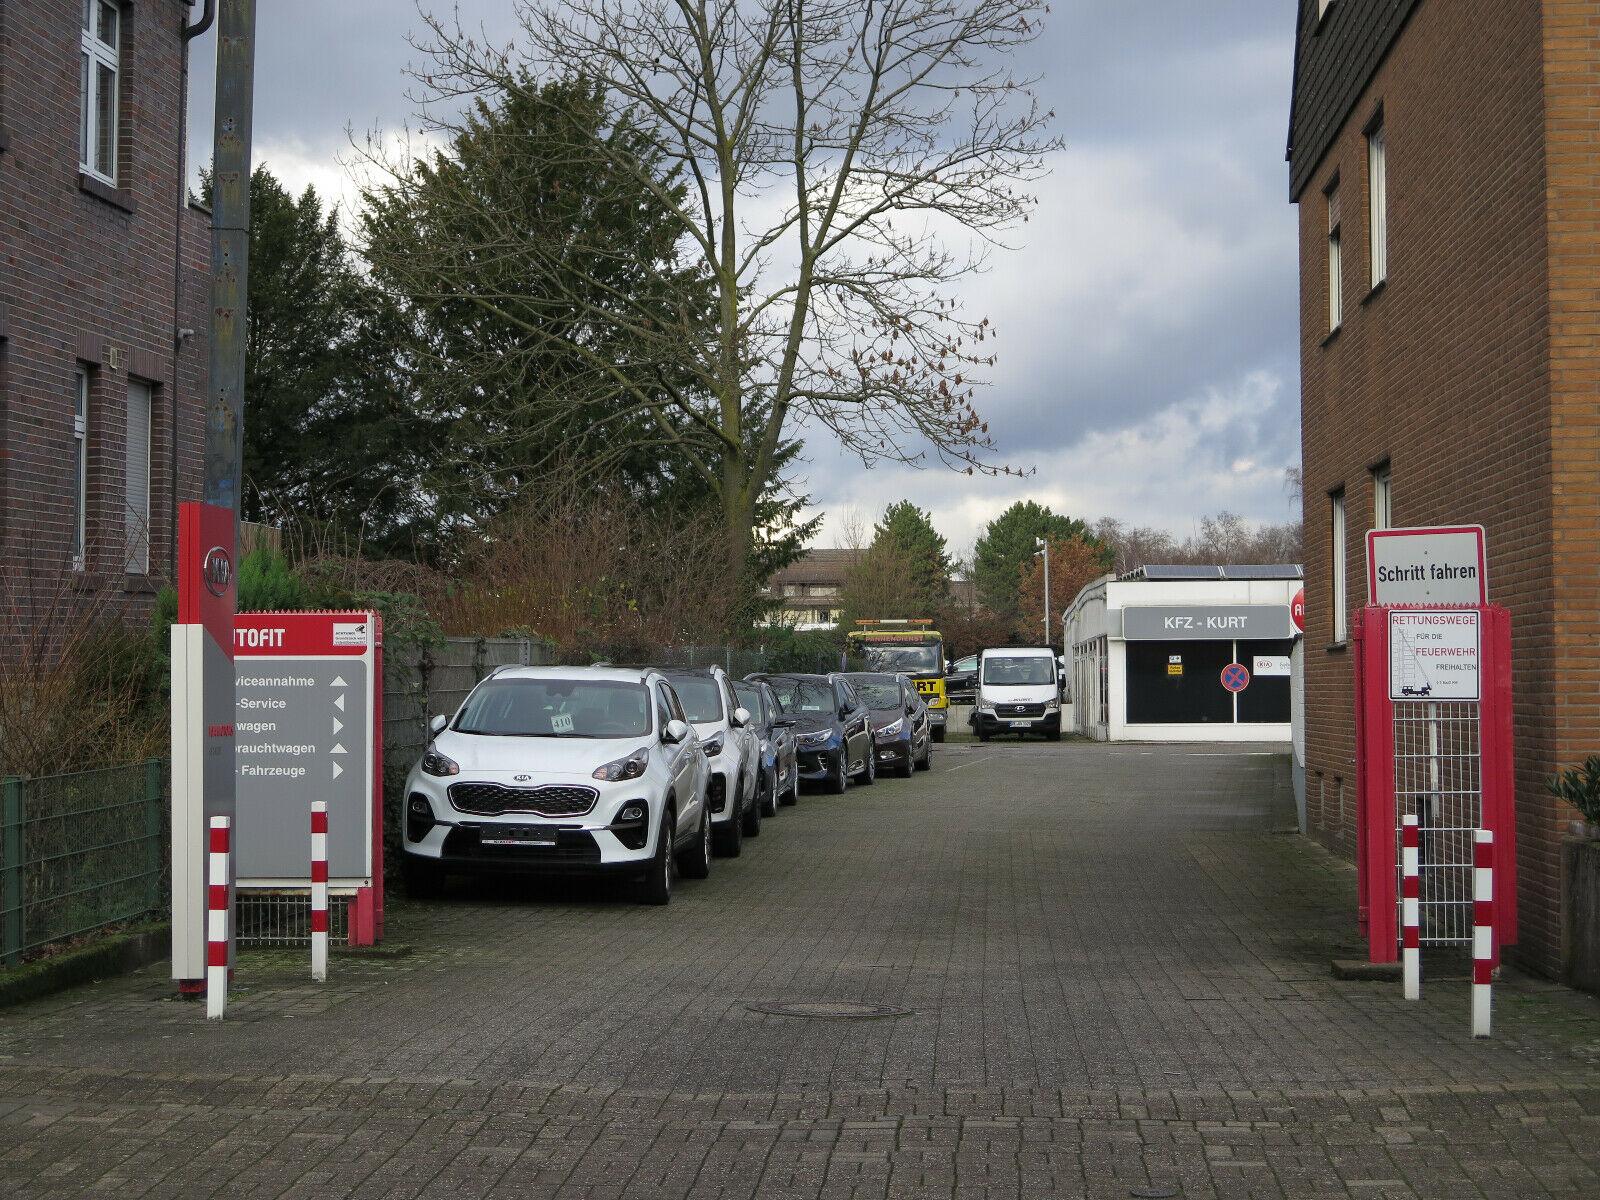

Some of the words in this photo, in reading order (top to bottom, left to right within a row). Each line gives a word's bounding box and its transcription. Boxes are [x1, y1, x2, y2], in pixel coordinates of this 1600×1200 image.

[1378, 565, 1425, 582] Schritt
[1430, 563, 1476, 580] fahren
[1294, 604, 1304, 616] A
[1164, 616, 1193, 629] KFZ
[1206, 616, 1248, 629] KURT
[1392, 615, 1476, 625] RETTUNGSWEGE
[233, 628, 286, 647] TOFIT
[1416, 647, 1476, 657] FEUERWEHR
[1436, 663, 1477, 671] FREIHALTEN
[914, 681, 937, 692] RT
[241, 765, 306, 778] Fahrzeuge
[515, 774, 531, 782] KIA
